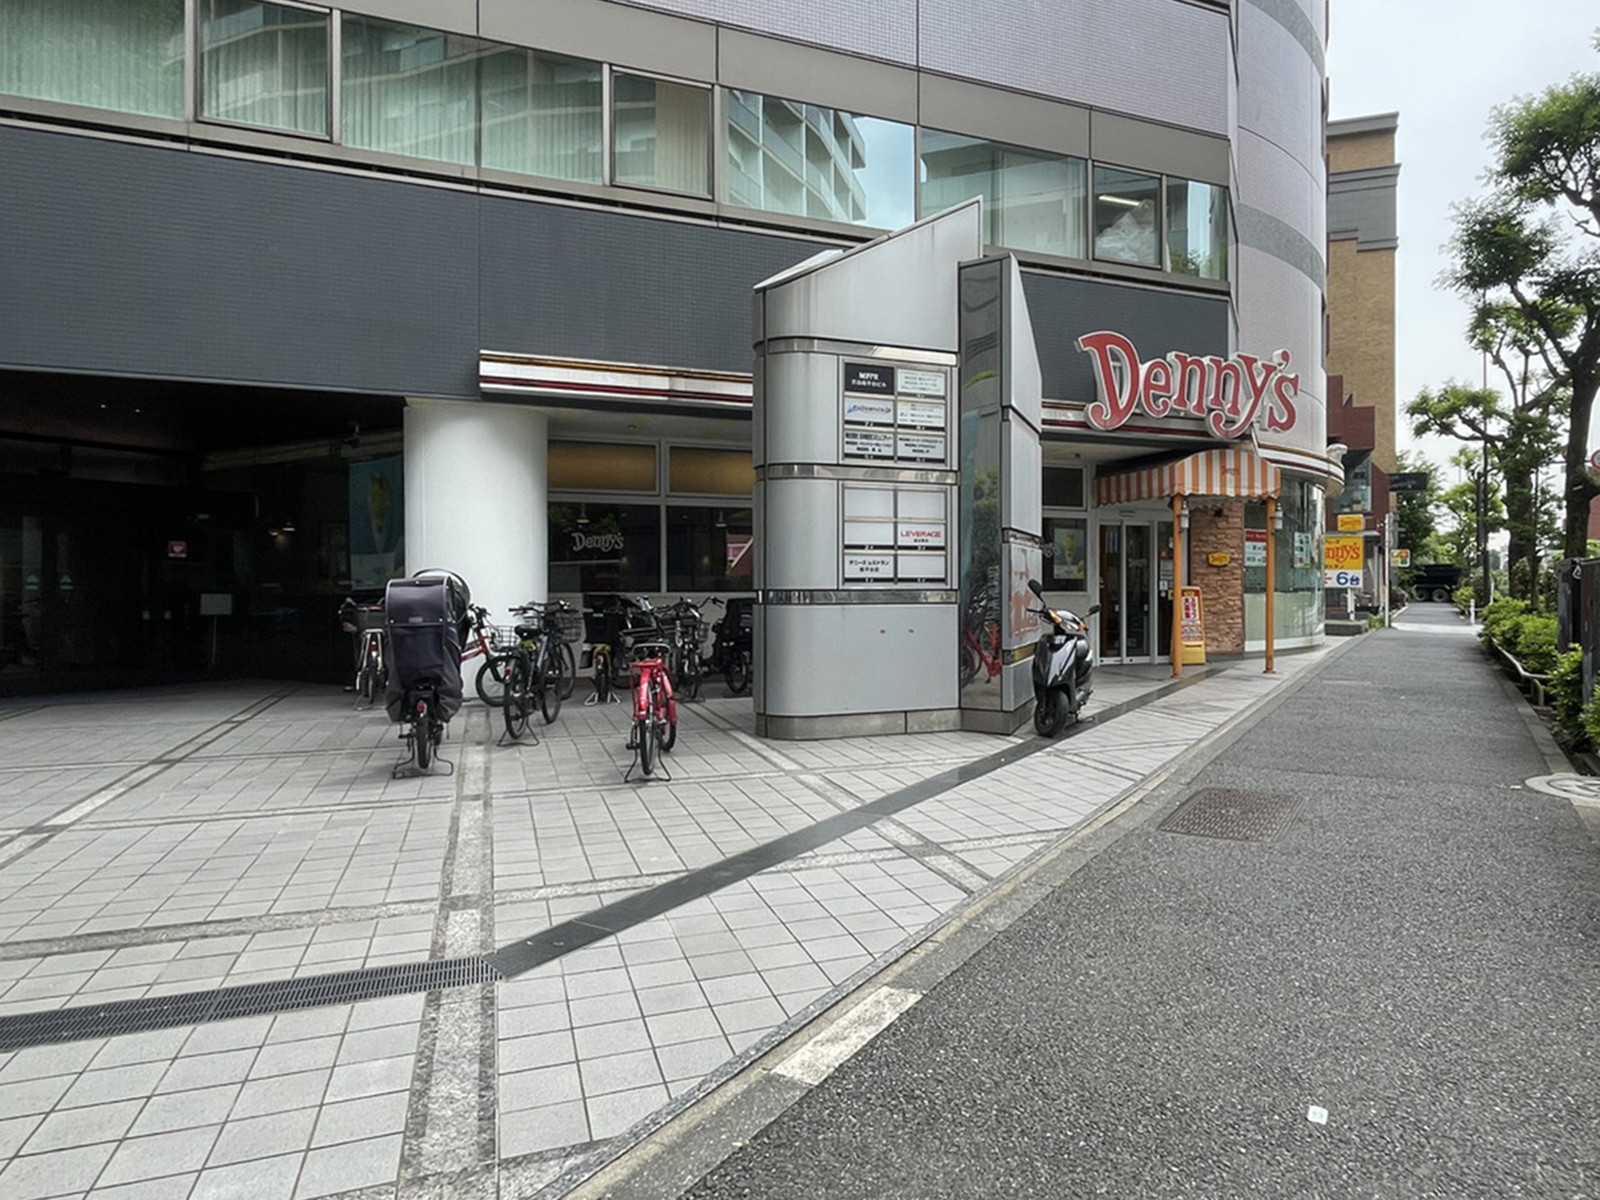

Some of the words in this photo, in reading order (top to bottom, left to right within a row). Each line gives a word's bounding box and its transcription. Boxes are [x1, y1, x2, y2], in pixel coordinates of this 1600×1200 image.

[1077, 331, 1299, 438] Denny's
[571, 532, 624, 552] Denny's
[900, 530, 941, 538] LEVERAGE
